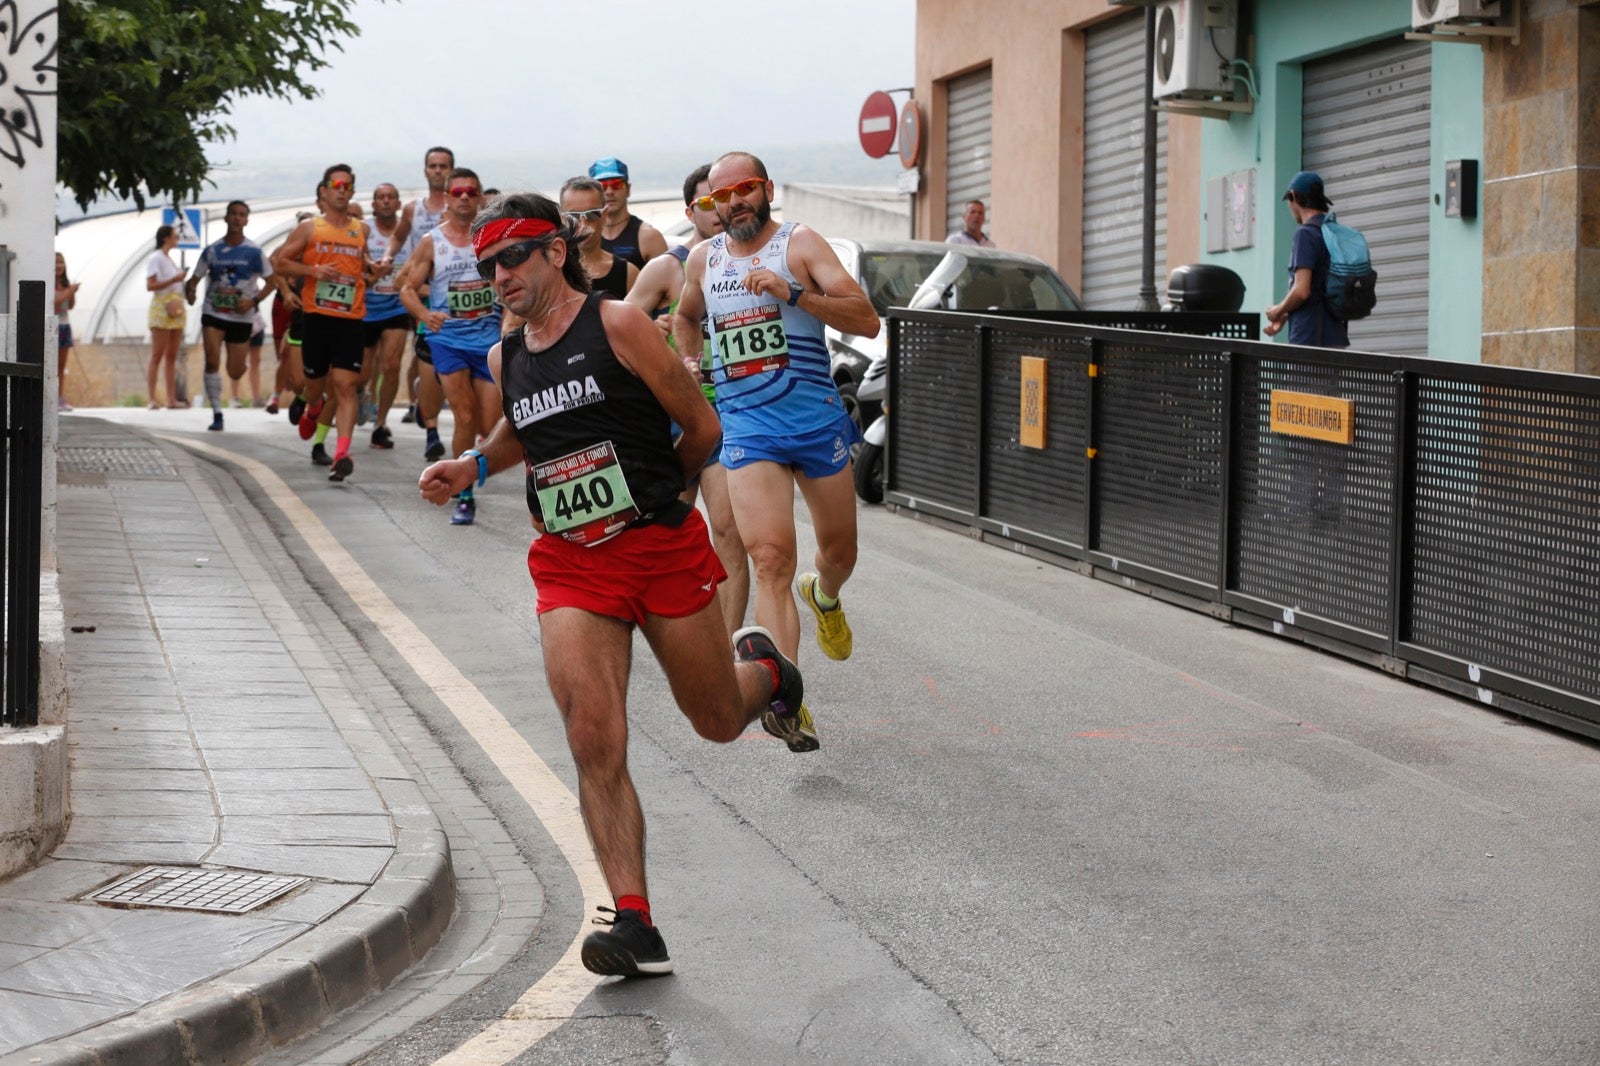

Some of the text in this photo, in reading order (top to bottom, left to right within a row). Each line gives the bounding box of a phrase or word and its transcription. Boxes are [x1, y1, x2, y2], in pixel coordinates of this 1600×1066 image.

[328, 285, 346, 299] 74
[452, 290, 492, 308] 1080
[711, 280, 745, 294] MARA
[720, 324, 785, 358] 1183
[513, 375, 601, 422] GRANADA
[1276, 402, 1342, 432] CERVEZAS ALHAMBRA
[556, 456, 578, 472] PREMIO
[578, 453, 587, 465] DE
[587, 445, 608, 461] FONDO
[555, 476, 614, 520] 440
